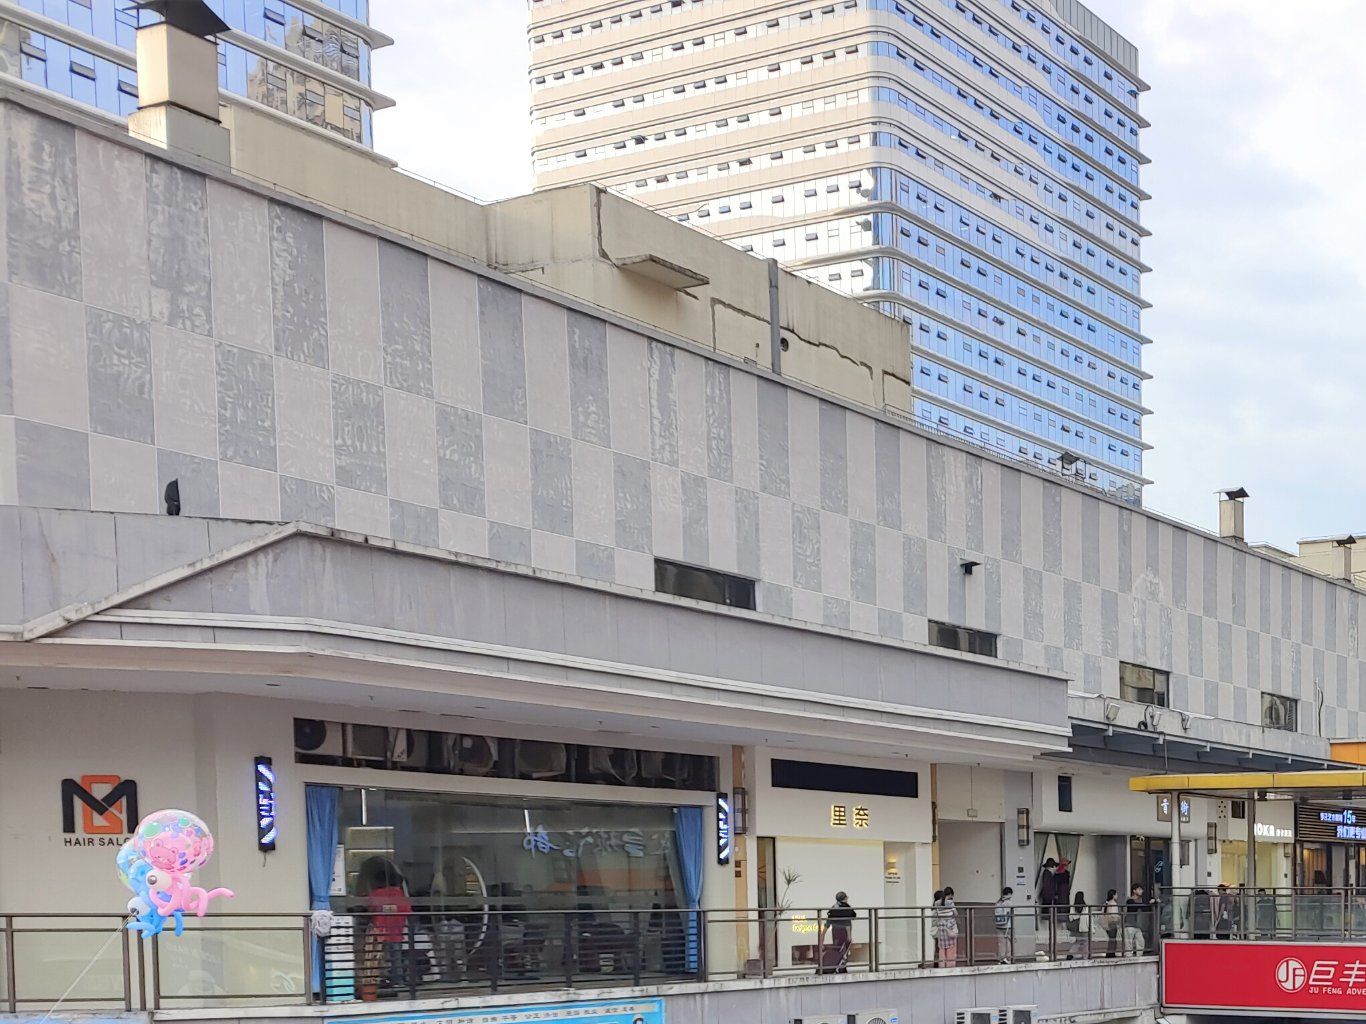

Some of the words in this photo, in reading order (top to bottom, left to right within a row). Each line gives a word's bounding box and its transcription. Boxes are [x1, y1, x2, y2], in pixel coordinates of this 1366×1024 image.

[829, 804, 870, 829] 里奈
[64, 837, 95, 847] HAIR
[1322, 987, 1343, 995] FENG
